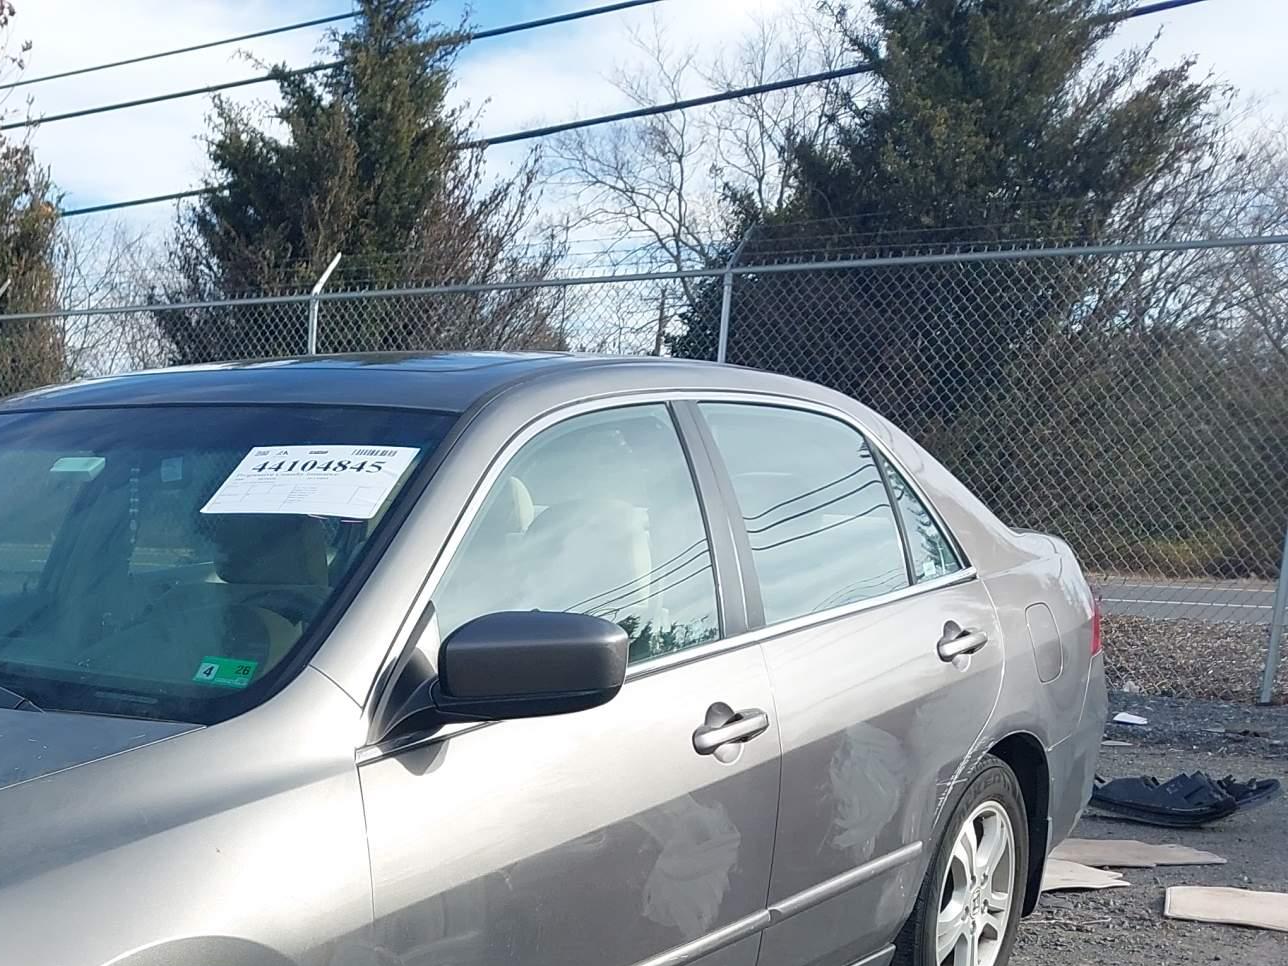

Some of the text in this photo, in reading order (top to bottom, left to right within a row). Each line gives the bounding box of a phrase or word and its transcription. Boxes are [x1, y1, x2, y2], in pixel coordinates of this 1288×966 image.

[252, 459, 386, 473] 44104845
[203, 664, 251, 677] 4 26
